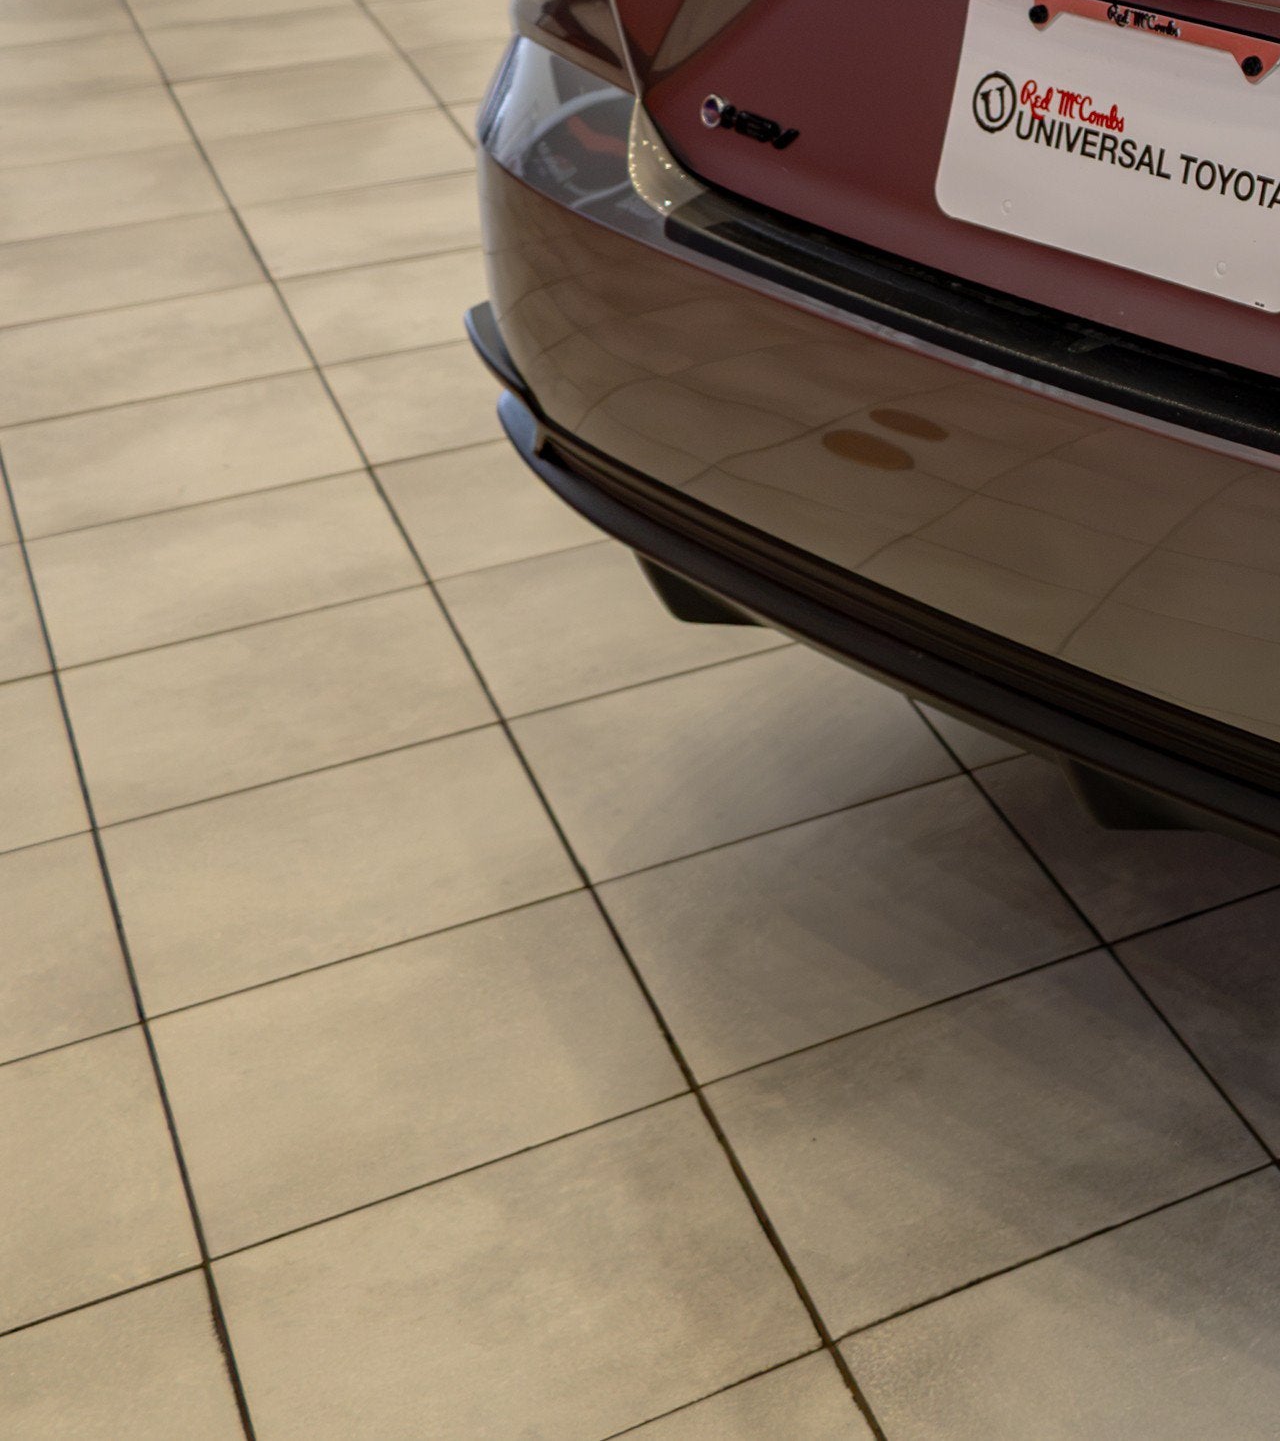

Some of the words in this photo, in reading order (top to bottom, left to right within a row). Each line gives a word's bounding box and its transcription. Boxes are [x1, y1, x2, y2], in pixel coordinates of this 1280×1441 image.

[1107, 3, 1130, 28] Red
[1131, 10, 1181, 37] McCombs
[1020, 79, 1054, 120] Red
[1056, 88, 1125, 133] McCombs
[1015, 110, 1172, 180] UNIVERSAL
